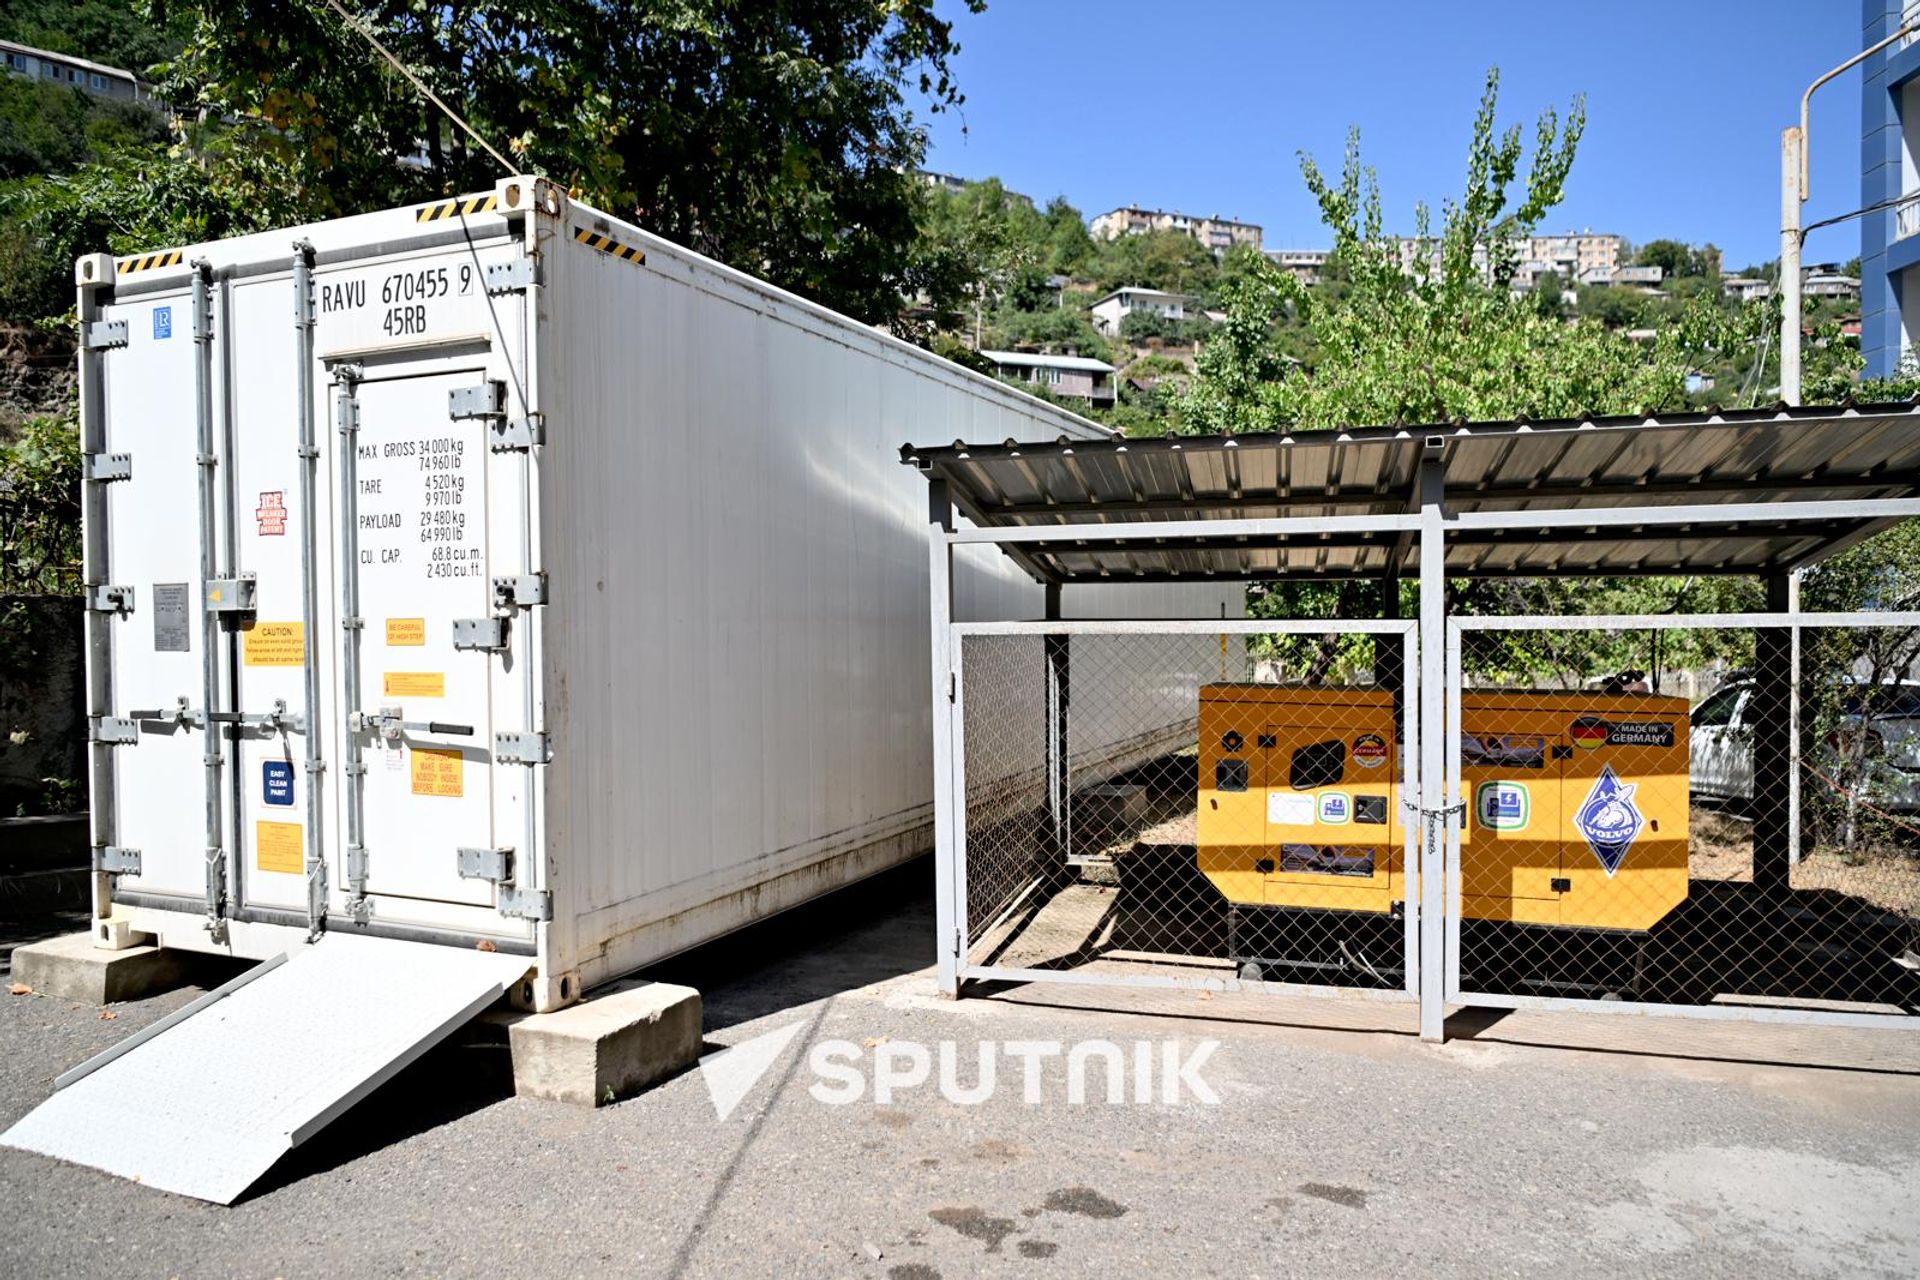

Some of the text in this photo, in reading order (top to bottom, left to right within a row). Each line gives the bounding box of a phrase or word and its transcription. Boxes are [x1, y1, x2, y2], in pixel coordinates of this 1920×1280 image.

[322, 265, 471, 313] RAVU 670455 9
[383, 305, 427, 337] 45RB
[358, 444, 378, 460] MAX
[383, 441, 416, 458] GROSS
[359, 478, 382, 495] TARE
[261, 493, 282, 509] ICE
[359, 513, 402, 529] PAYLOAD
[361, 549, 376, 564] CU.
[1621, 725, 1658, 733] MADE IN
[1611, 733, 1668, 743] GERMANY
[270, 770, 285, 778] EASY
[269, 780, 287, 788] CLEAN
[270, 789, 287, 797] PAINT
[1585, 824, 1634, 839] VOLVO
